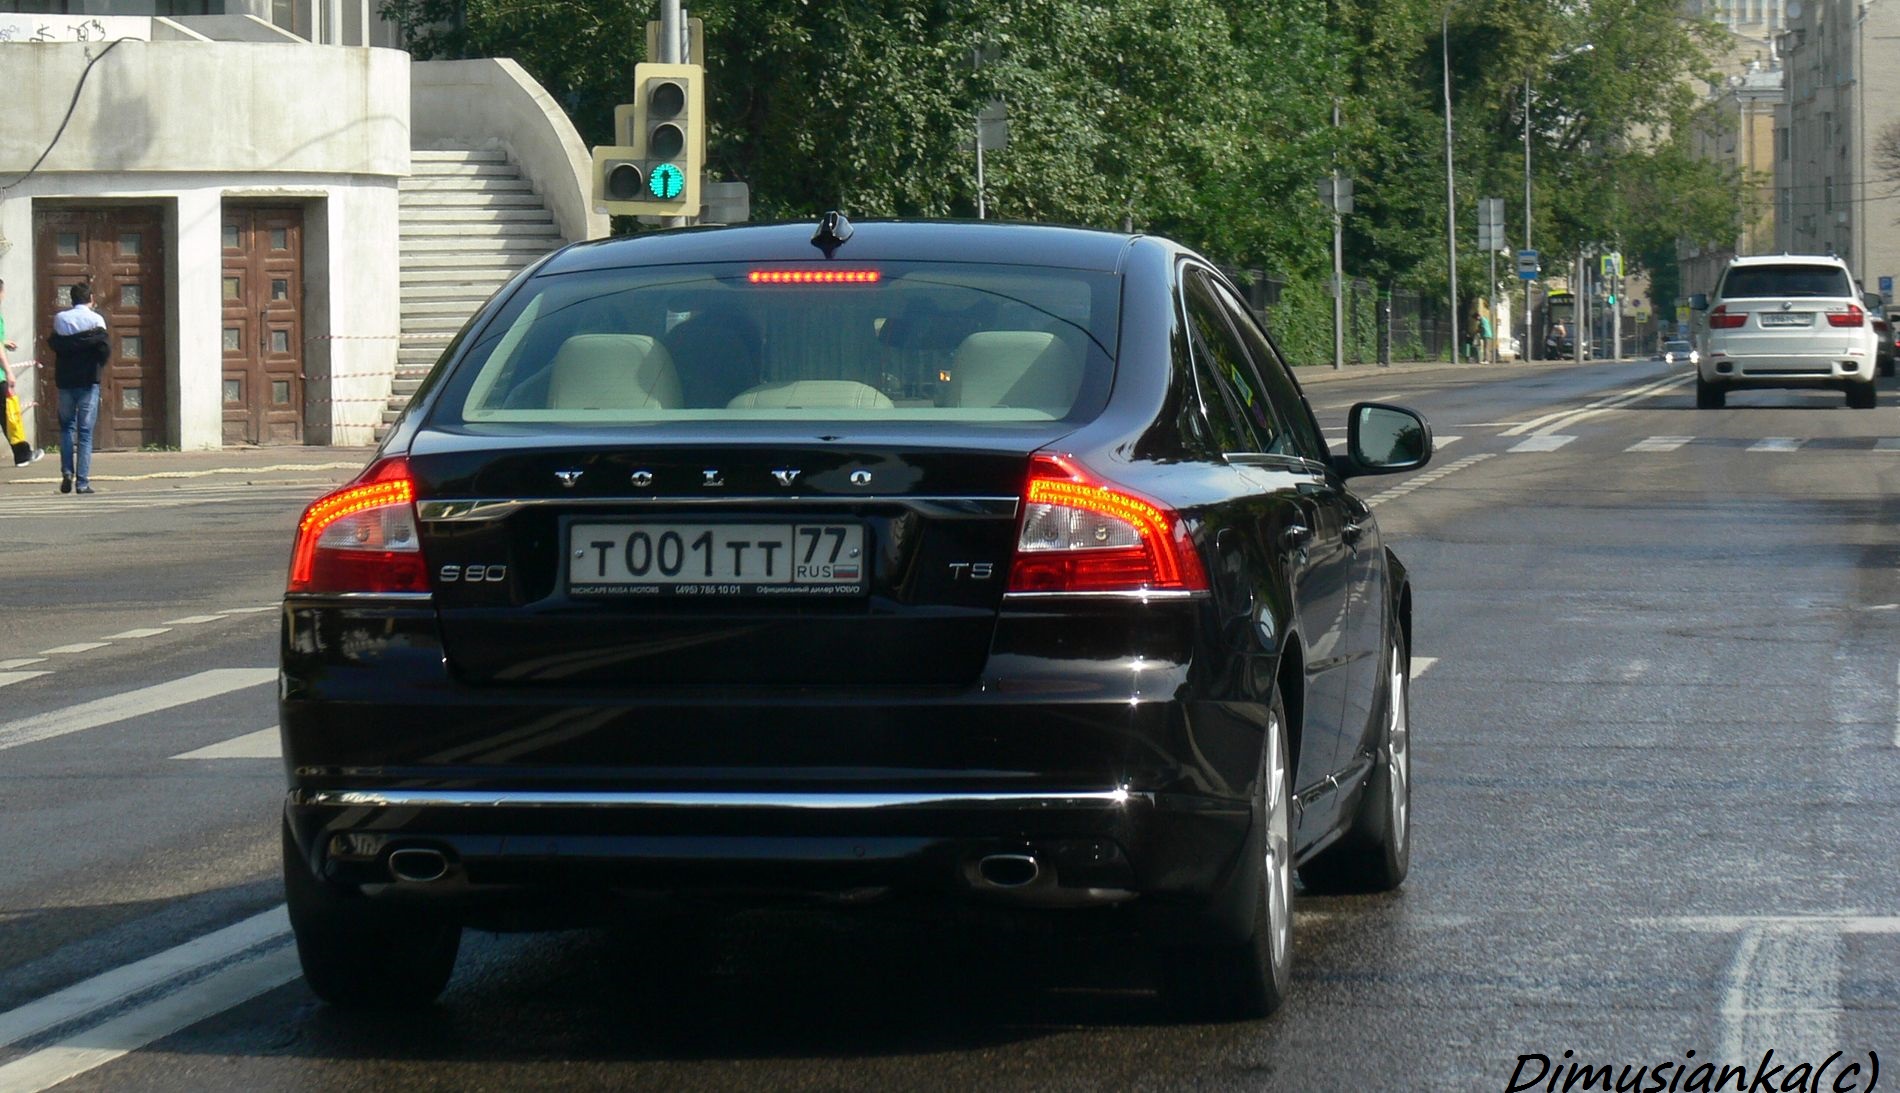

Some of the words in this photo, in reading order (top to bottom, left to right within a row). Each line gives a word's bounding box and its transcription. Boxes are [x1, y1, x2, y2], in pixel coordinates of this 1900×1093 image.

[554, 470, 872, 488] VOLVO
[590, 530, 783, 577] T001TT
[799, 527, 847, 564] 77
[440, 564, 507, 582] S80
[796, 565, 832, 578] RUS
[948, 562, 994, 581] T5
[717, 585, 729, 594] 10
[729, 585, 741, 594] 01
